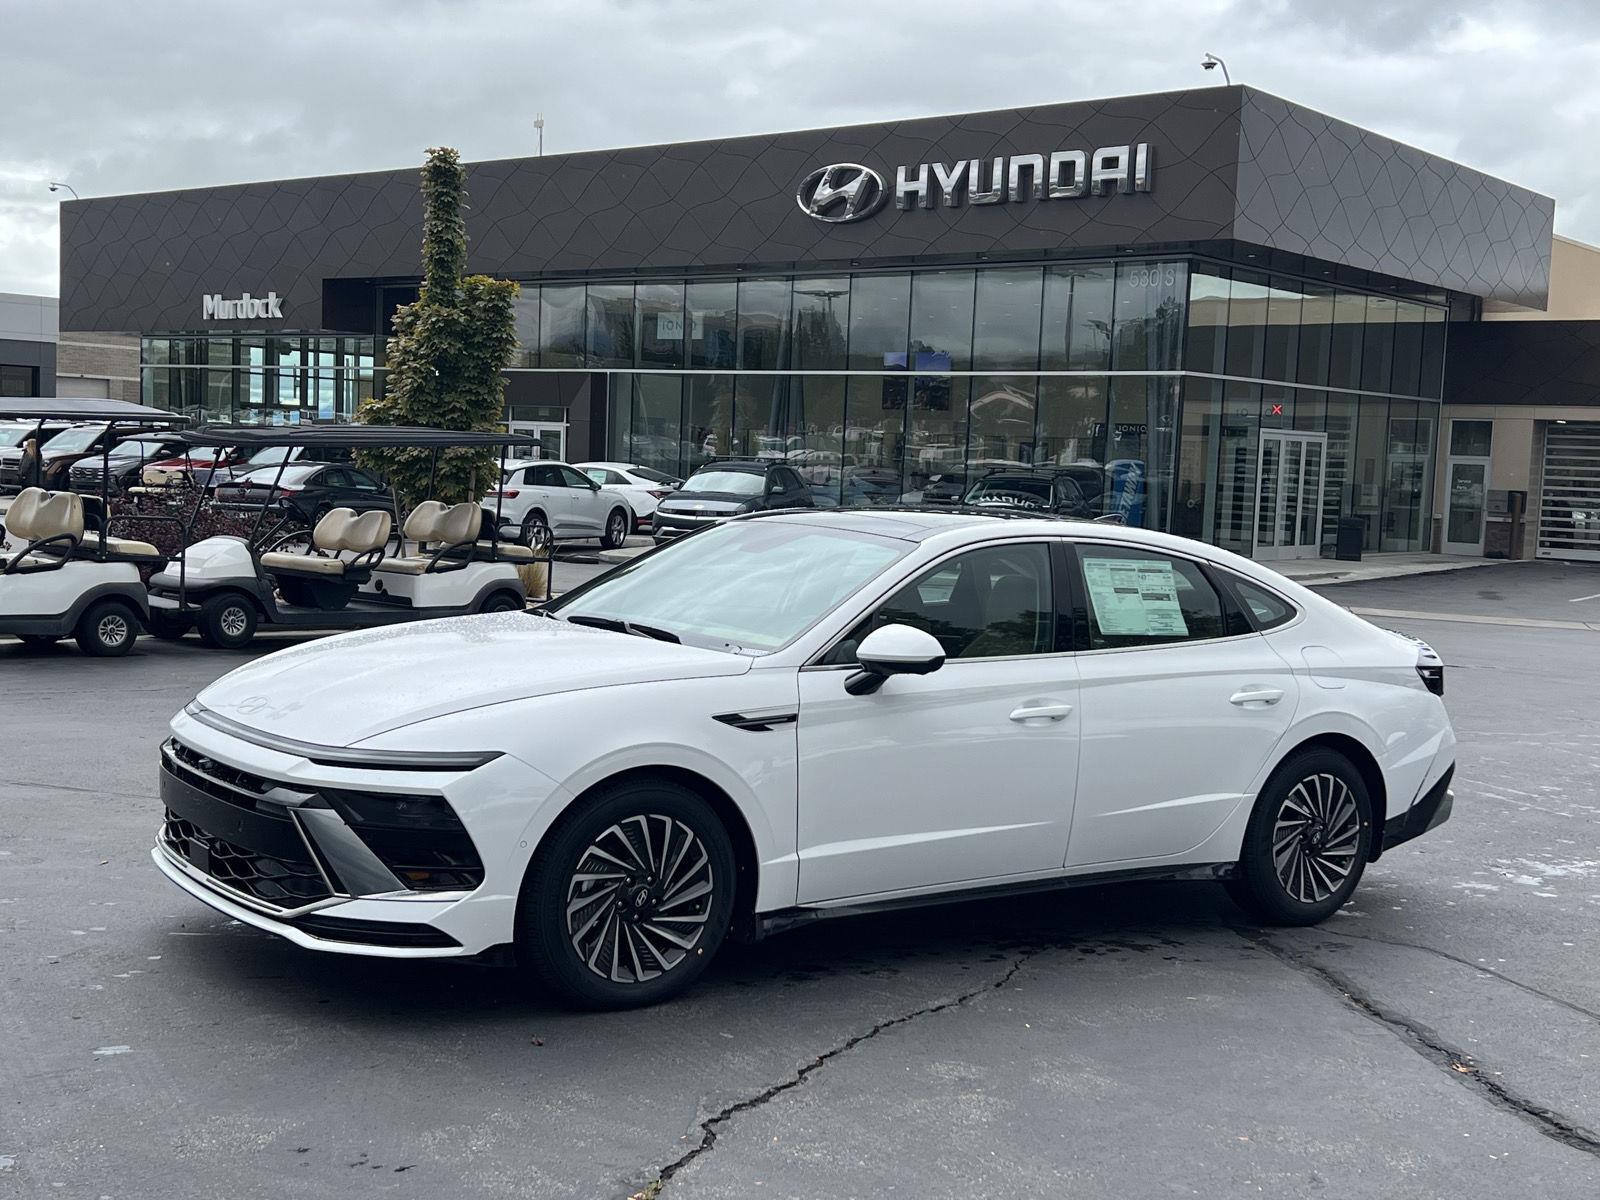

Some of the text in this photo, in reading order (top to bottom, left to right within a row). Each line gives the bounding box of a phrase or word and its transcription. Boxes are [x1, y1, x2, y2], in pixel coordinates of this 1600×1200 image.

[896, 143, 1152, 209] HYUNDAI
[1129, 269, 1175, 287] 530 S
[203, 292, 283, 320] Murdock
